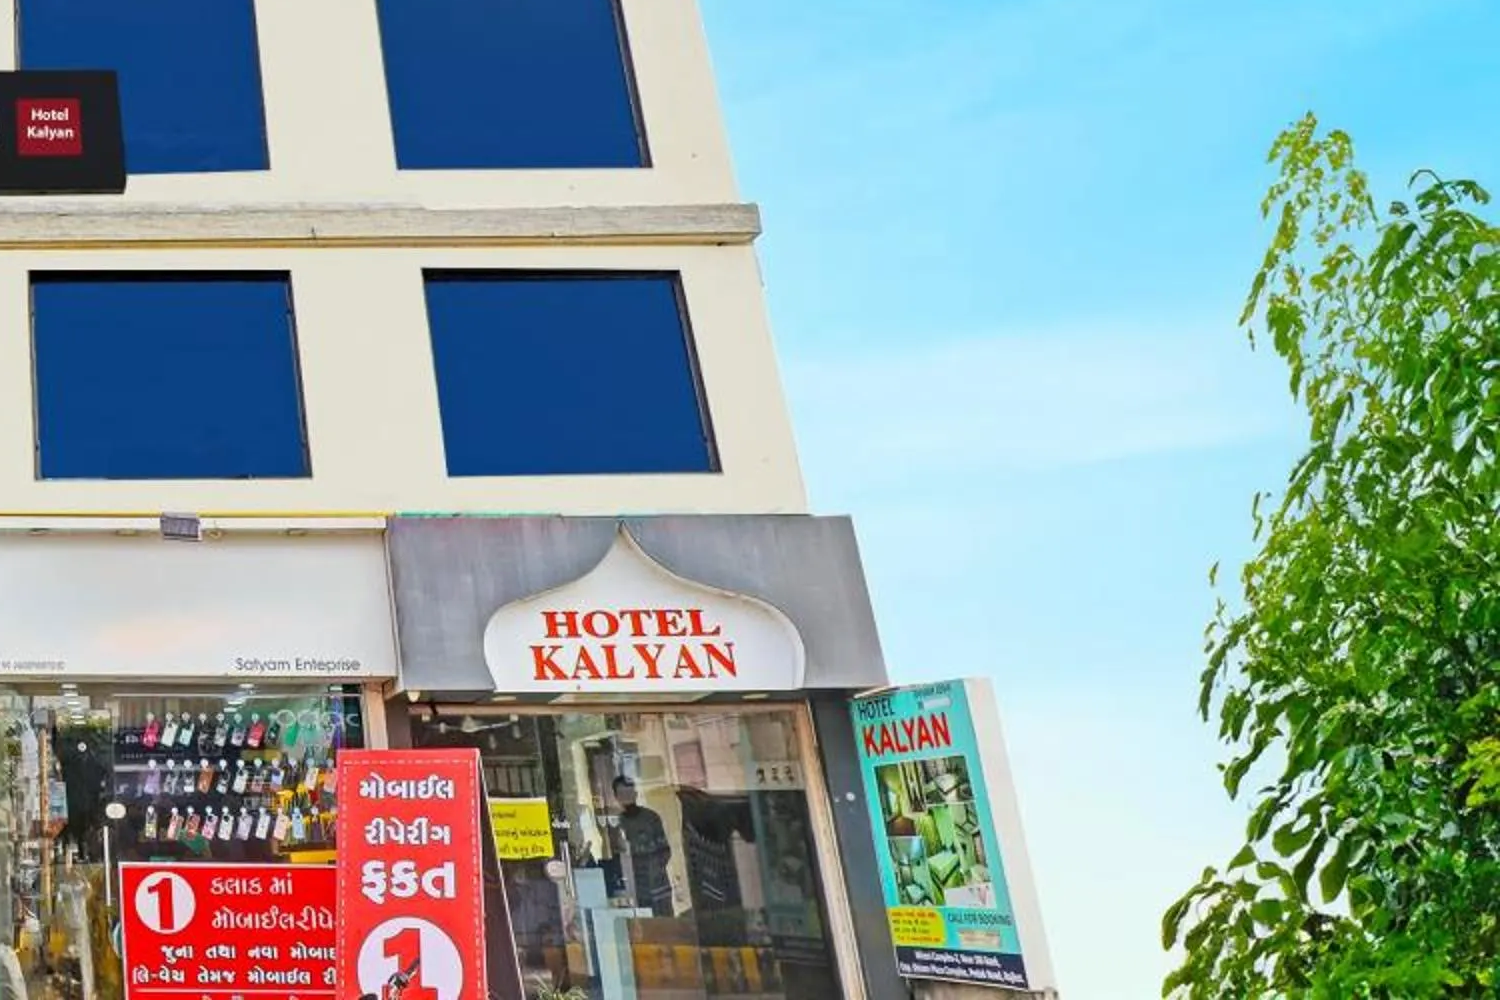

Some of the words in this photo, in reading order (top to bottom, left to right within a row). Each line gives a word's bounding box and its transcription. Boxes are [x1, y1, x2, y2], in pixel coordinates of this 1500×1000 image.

[31, 108, 69, 121] Hotel
[27, 126, 74, 141] Kalyan
[541, 609, 722, 639] HOTEL
[235, 658, 291, 672] Satyam
[296, 658, 360, 672] Enteprise
[529, 642, 738, 681] KALYAN
[858, 698, 895, 719] HOTEL
[863, 712, 951, 757] KALYAN
[210, 877, 263, 896] કલાક
[270, 873, 294, 896] માં
[148, 877, 174, 931] 1
